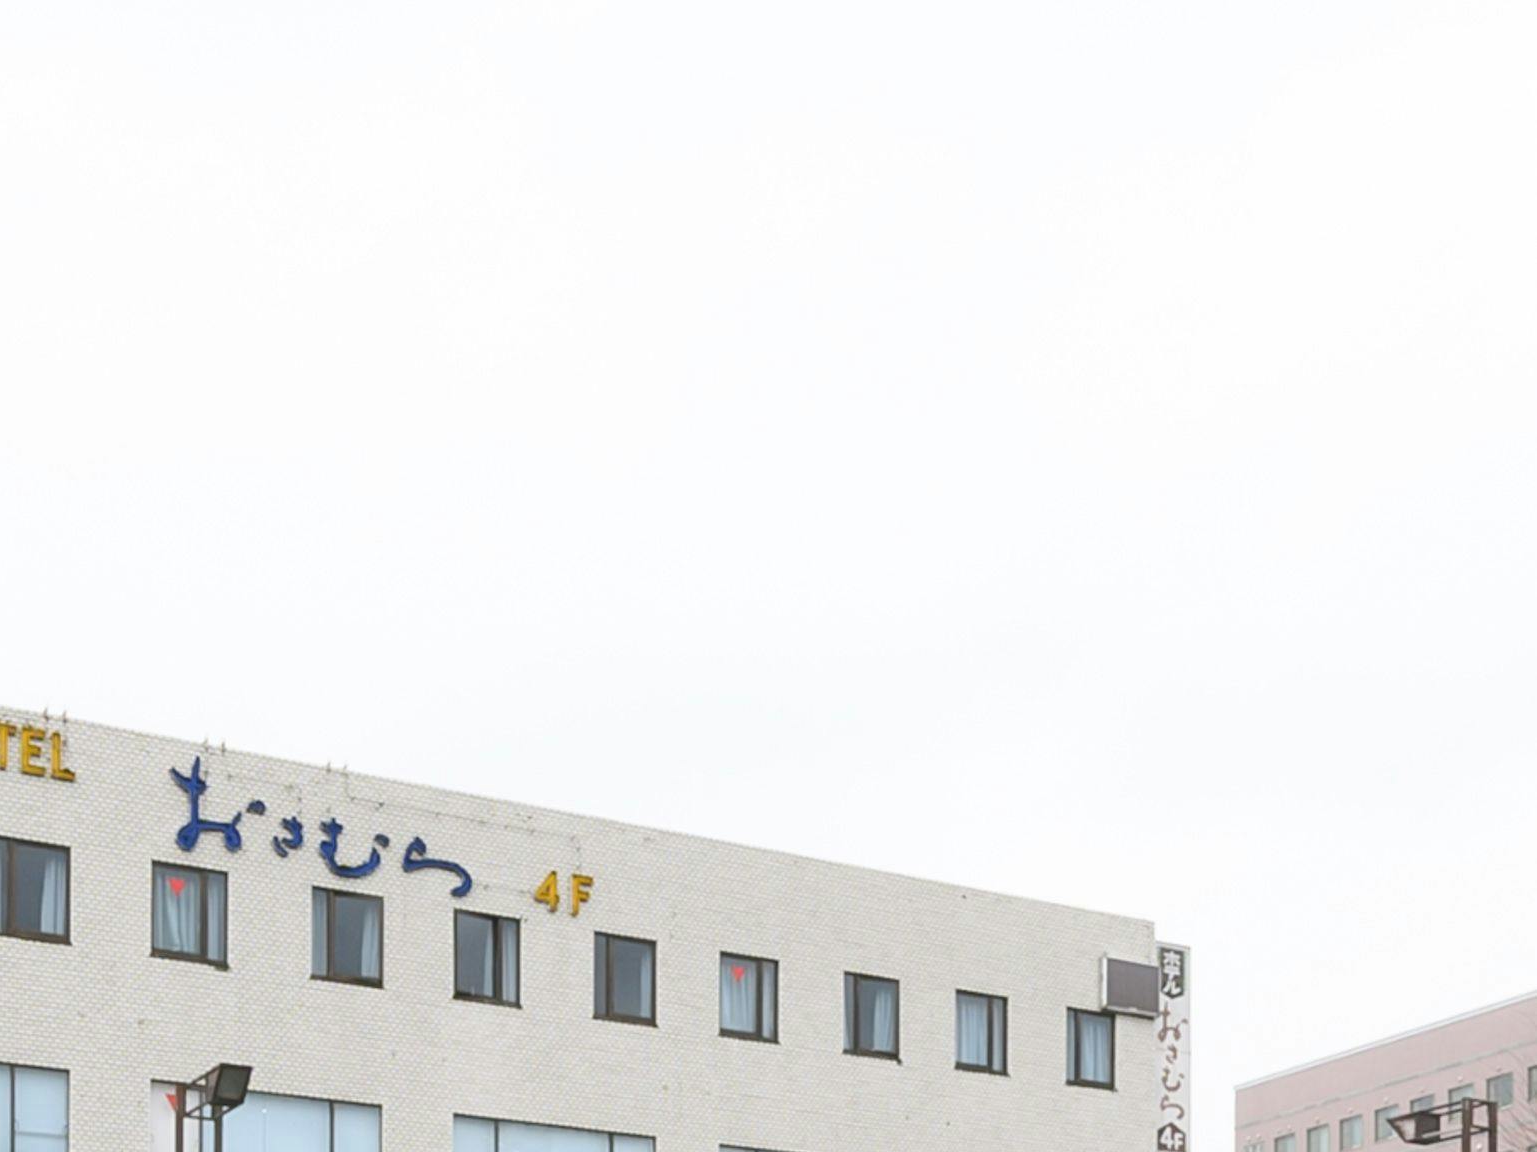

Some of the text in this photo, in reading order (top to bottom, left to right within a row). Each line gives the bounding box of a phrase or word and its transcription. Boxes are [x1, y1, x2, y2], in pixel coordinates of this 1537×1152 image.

[534, 871, 594, 917] 4F
[1163, 950, 1182, 995] ホテル
[1160, 1127, 1185, 1151] 4F
